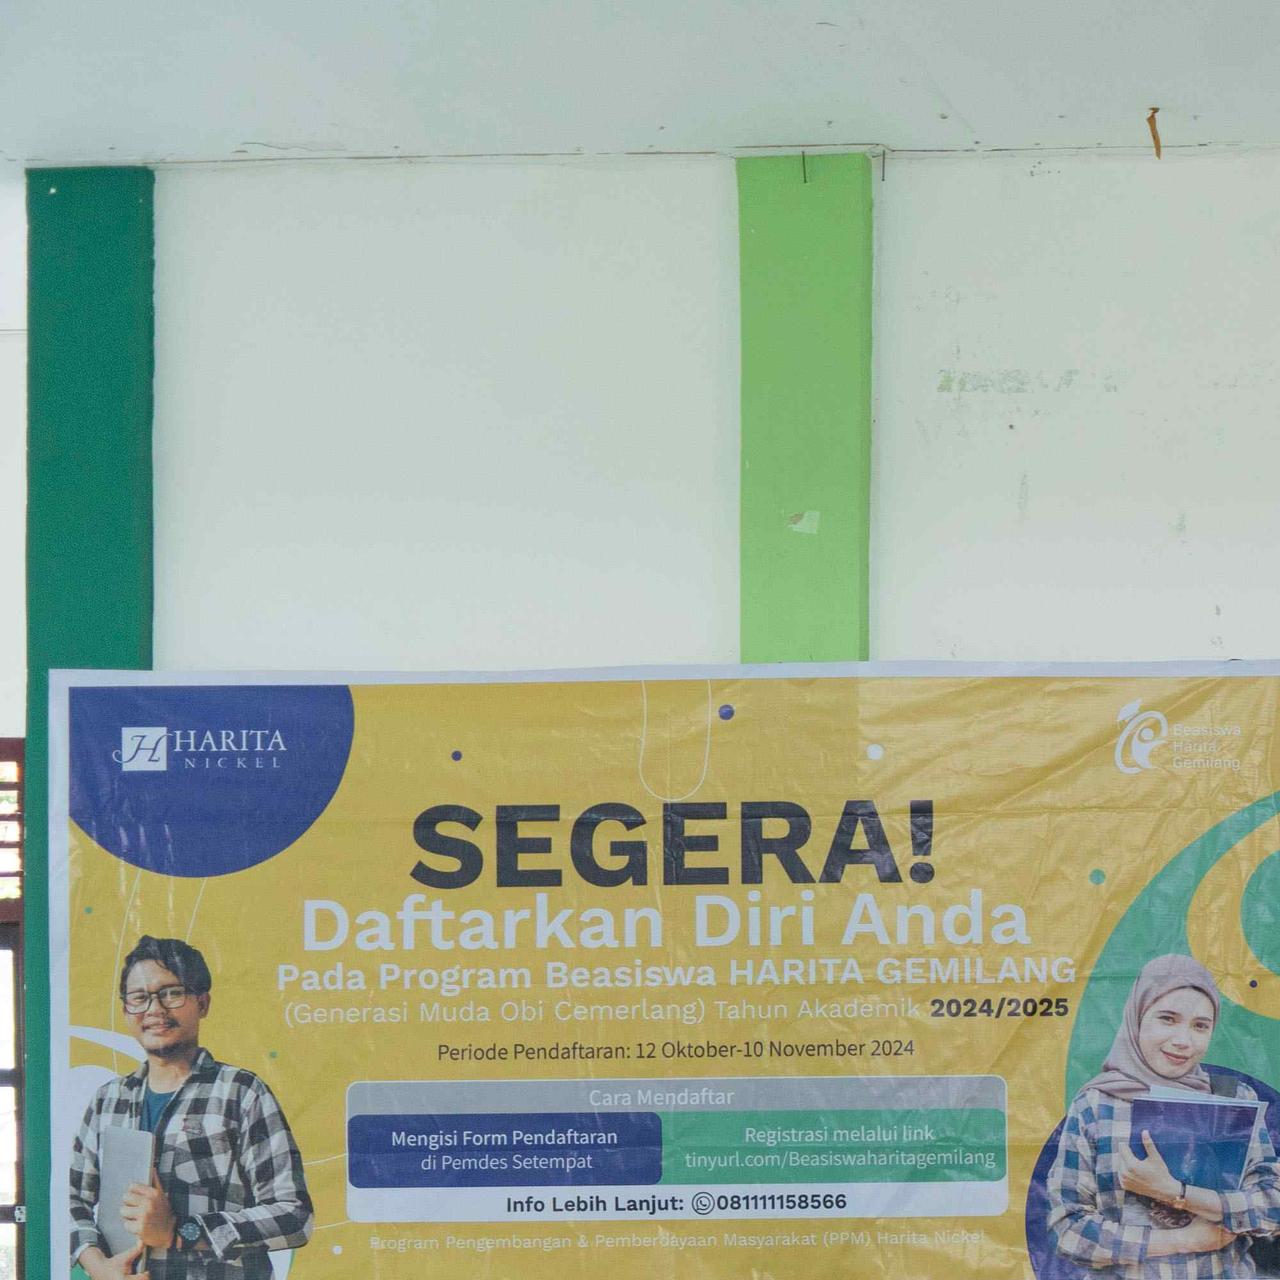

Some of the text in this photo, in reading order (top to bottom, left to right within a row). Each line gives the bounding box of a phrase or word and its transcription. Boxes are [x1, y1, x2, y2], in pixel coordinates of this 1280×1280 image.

[173, 729, 288, 754] HARITA
[184, 756, 282, 770] NICKEL
[409, 800, 935, 890] SEGERA!
[303, 890, 1031, 951] Daftarkan Diri Anda
[277, 956, 1076, 997] Pada Program Beasiswa HARITA GEMILANG
[285, 998, 1069, 1028] (Generasi Muda Obi Cemerlang) Tahun Akademik 2024/2025
[438, 1039, 915, 1061] Periode Pendaftaran: 12 Oktober-10 November 2024
[589, 1087, 734, 1106] Cara Mendaftar
[391, 1128, 618, 1150] Mengisi Form Pendaftaran
[745, 1124, 935, 1146] Registrasi melalui link
[421, 1153, 593, 1174] di Pemdes Setempat
[685, 1149, 996, 1170] tinyurl.com/Beasiswaharitagemilang
[506, 1193, 847, 1214] Info Lebih Lanjut: 081111158566
[445, 1235, 571, 1252] Pengembangan
[723, 1232, 818, 1249] Masyarakat
[822, 1231, 872, 1249] (PPM)
[877, 1231, 928, 1246] Harita
